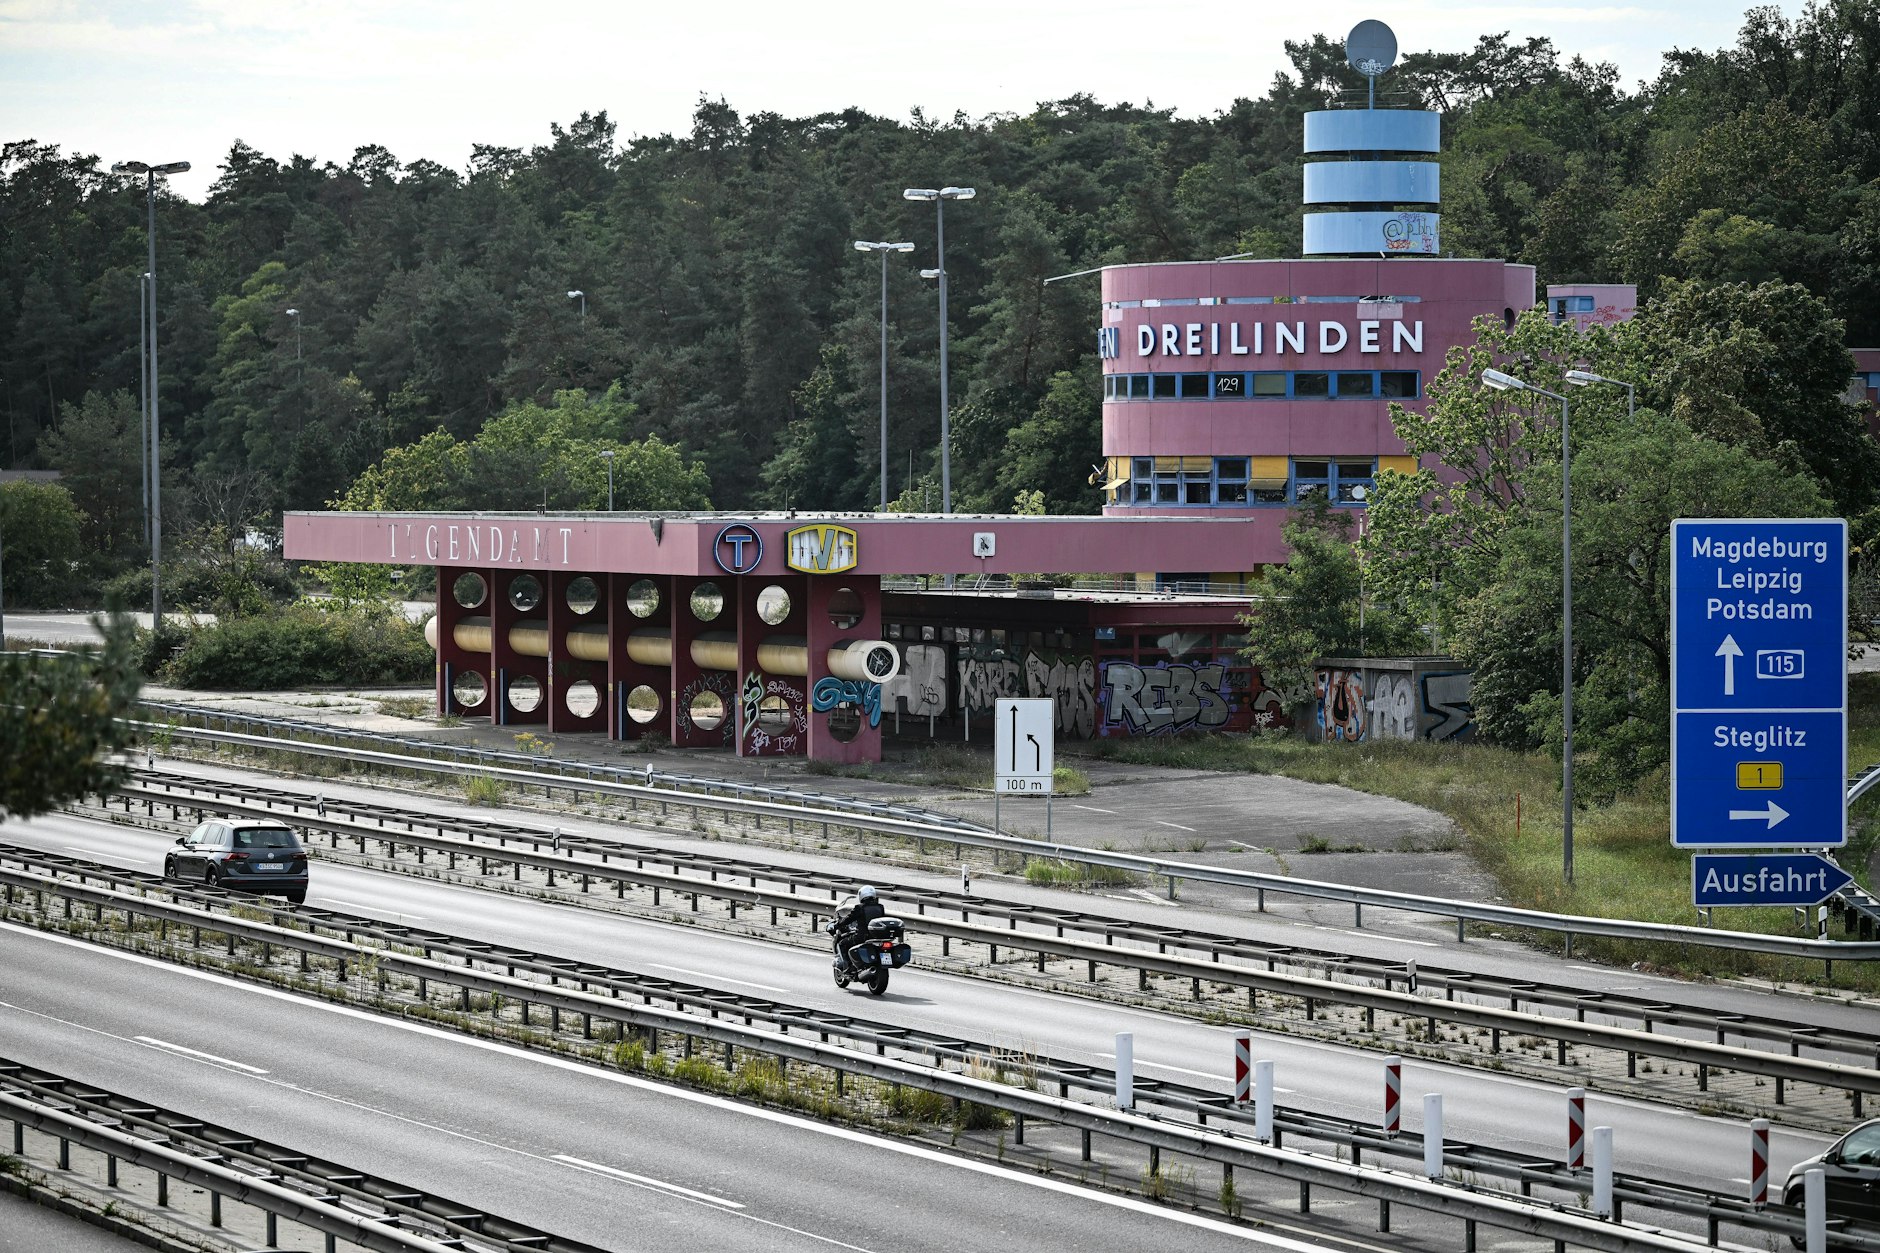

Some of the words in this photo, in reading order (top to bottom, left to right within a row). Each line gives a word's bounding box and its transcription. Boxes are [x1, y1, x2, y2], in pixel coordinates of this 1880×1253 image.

[1138, 320, 1423, 356] DREILINDEN
[1217, 377, 1239, 392] 129
[1692, 536, 1828, 564] Magdeburg
[1717, 567, 1802, 594] Leipzig
[1707, 598, 1813, 620] Potsdam
[1766, 655, 1795, 673] 115
[1104, 662, 1231, 735] REBS
[1714, 725, 1807, 753] Steglitz
[1006, 779, 1026, 790] 100
[1031, 781, 1042, 790] m
[1756, 767, 1763, 784] 1
[1701, 867, 1827, 893] Ausfahrt
